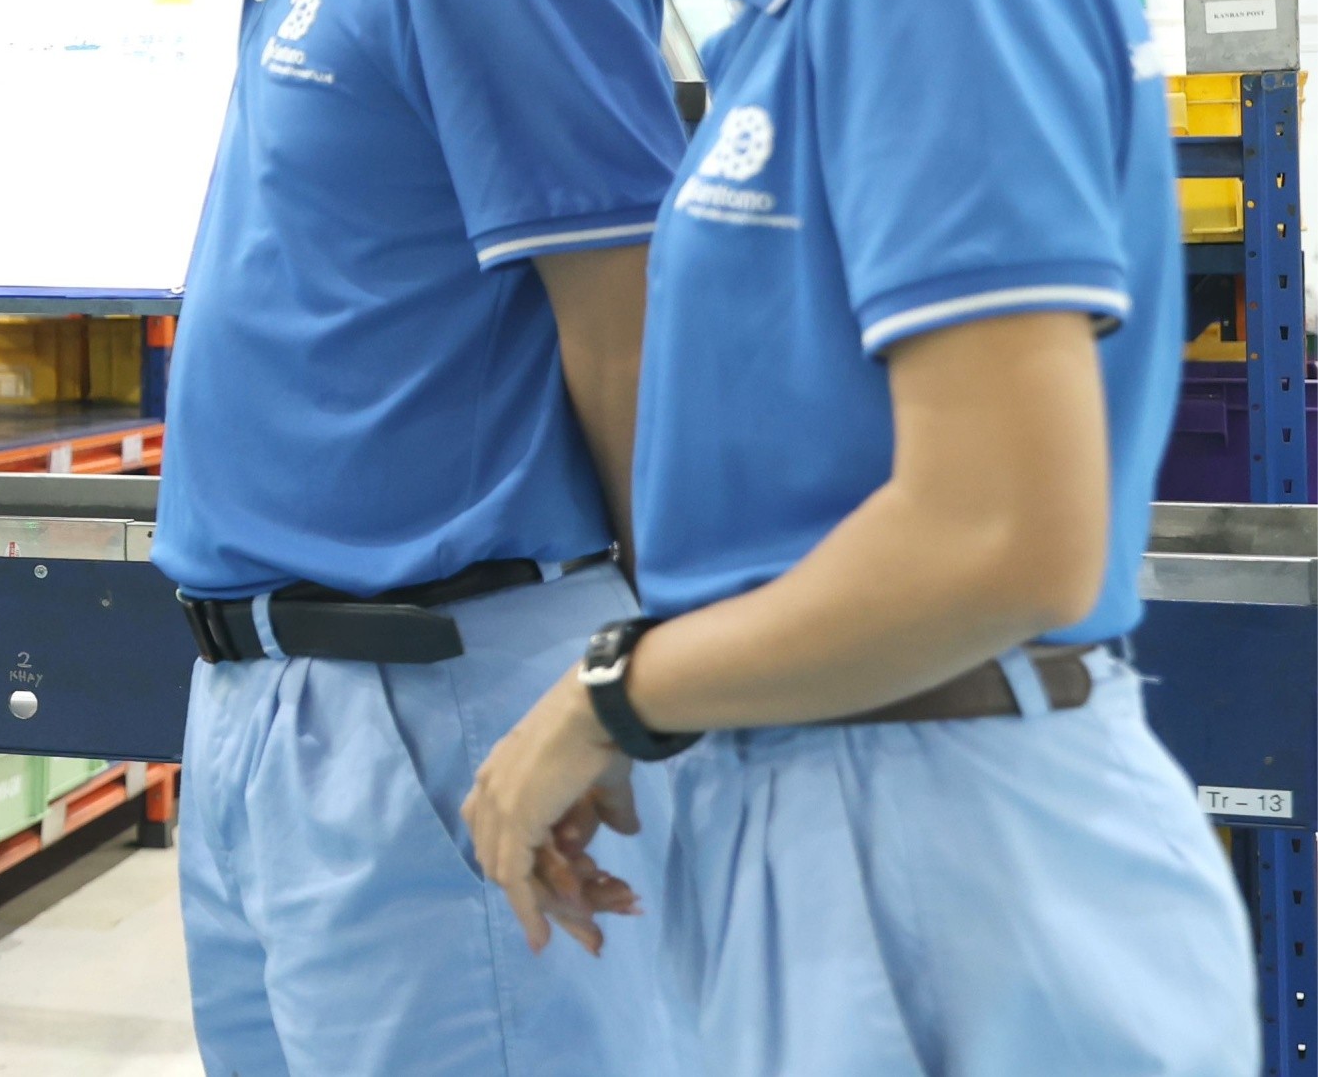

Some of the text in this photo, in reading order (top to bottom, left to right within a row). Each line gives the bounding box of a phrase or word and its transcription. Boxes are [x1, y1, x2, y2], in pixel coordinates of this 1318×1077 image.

[1246, 9, 1265, 17] POST
[17, 651, 32, 668] 2
[1206, 791, 1229, 809] Tr
[1258, 794, 1283, 812] 13
